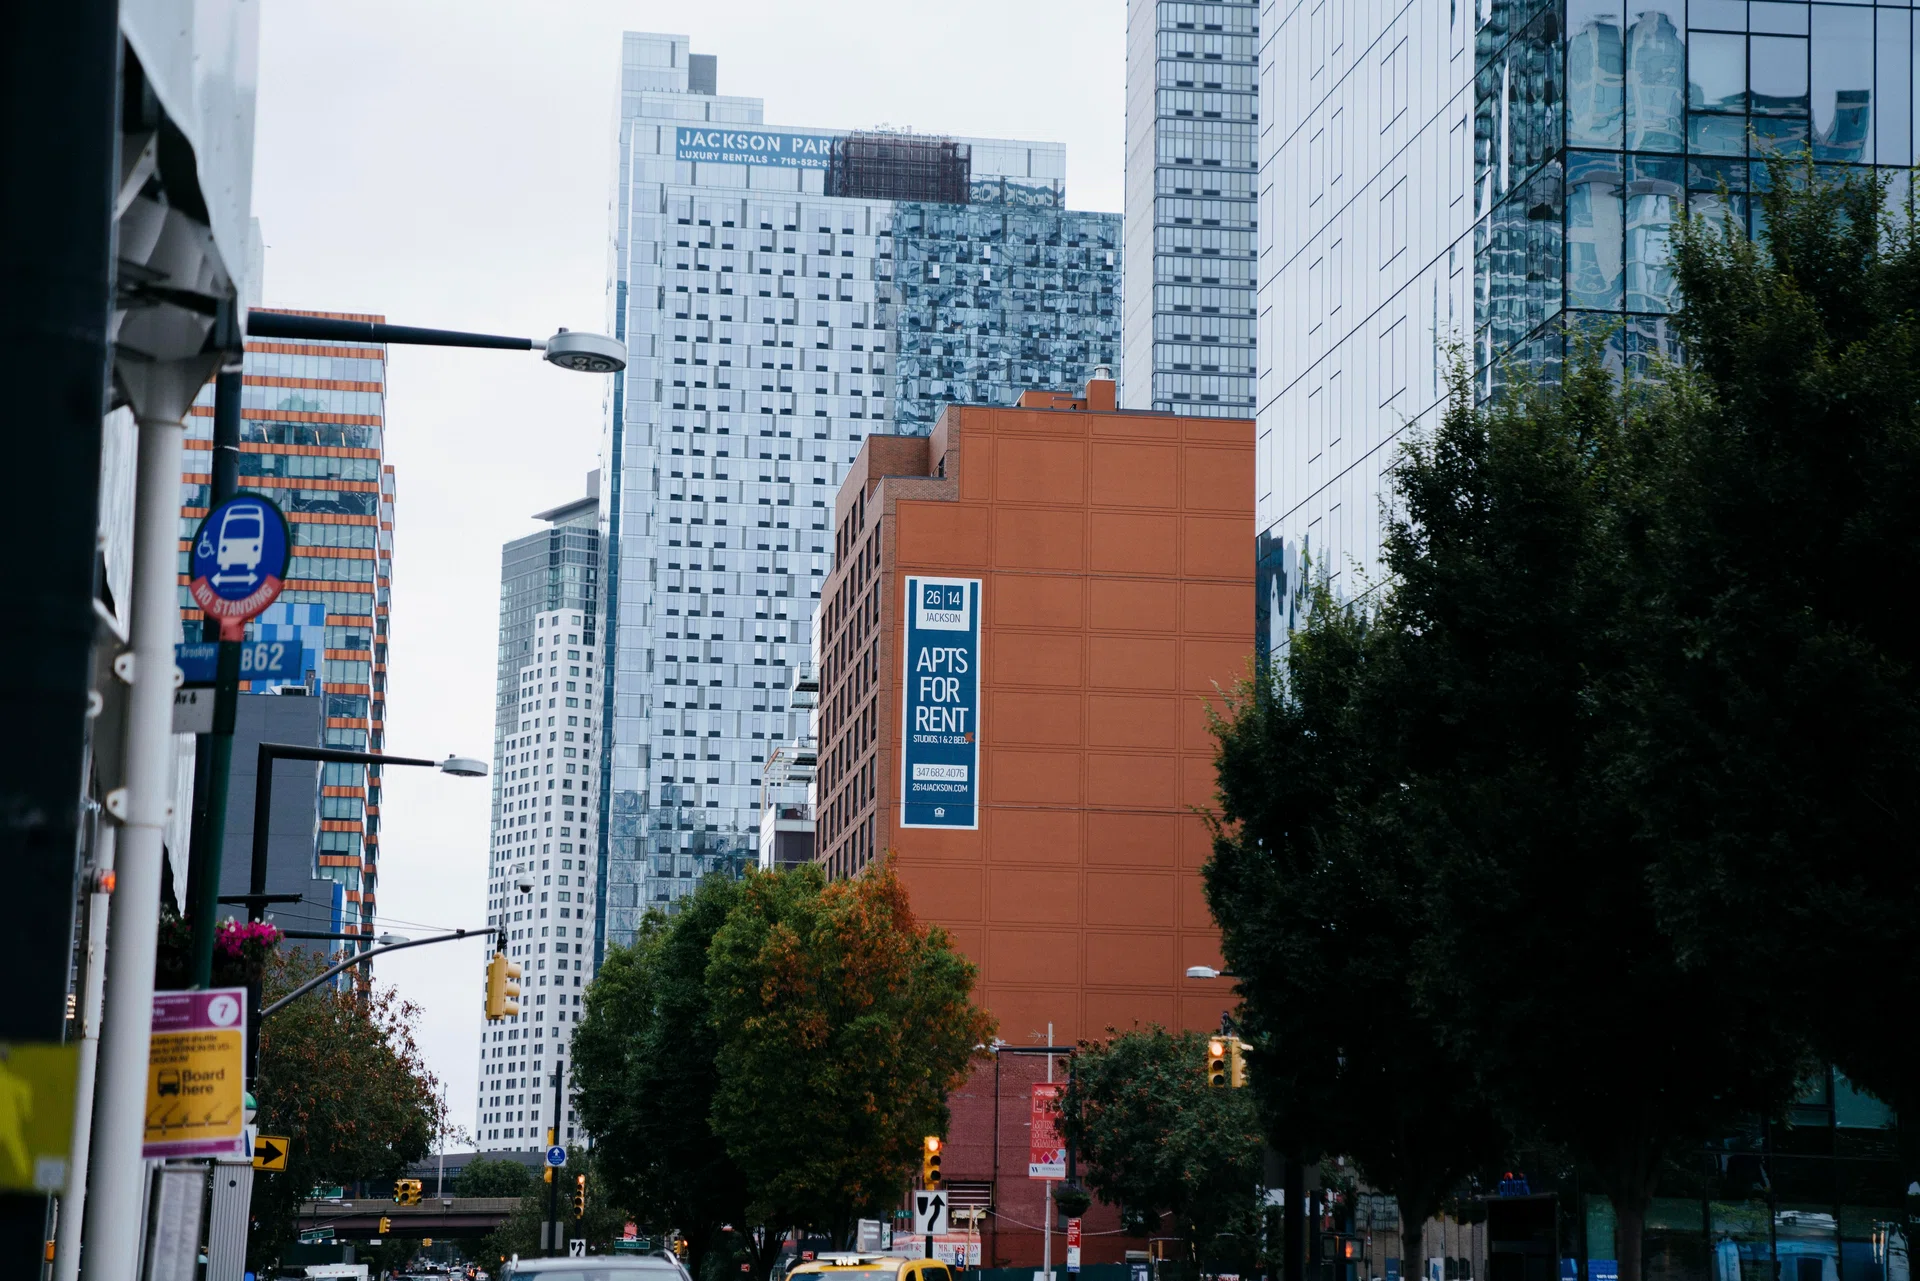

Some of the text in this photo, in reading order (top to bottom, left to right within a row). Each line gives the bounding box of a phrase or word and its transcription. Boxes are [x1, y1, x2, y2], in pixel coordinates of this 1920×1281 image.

[680, 131, 846, 155] JACKSON PARK
[680, 150, 719, 161] LUXURY
[722, 153, 768, 164] RENTALS
[196, 584, 273, 616] NO STANDING
[926, 590, 961, 606] 26 14
[925, 612, 961, 623] JACKSON
[180, 646, 214, 661] Brooklyn
[241, 643, 285, 671] B62
[916, 647, 968, 674] APTS
[920, 676, 960, 703] FOR
[915, 705, 969, 733] RENT
[942, 735, 948, 744] &
[948, 736, 953, 744] 2
[916, 767, 965, 778] 347.682.4076
[912, 783, 968, 793] 2614JACKSON.COM
[219, 1003, 229, 1018] 7
[182, 1067, 225, 1081] Board
[182, 1083, 213, 1096] here
[938, 1244, 950, 1252] MR.
